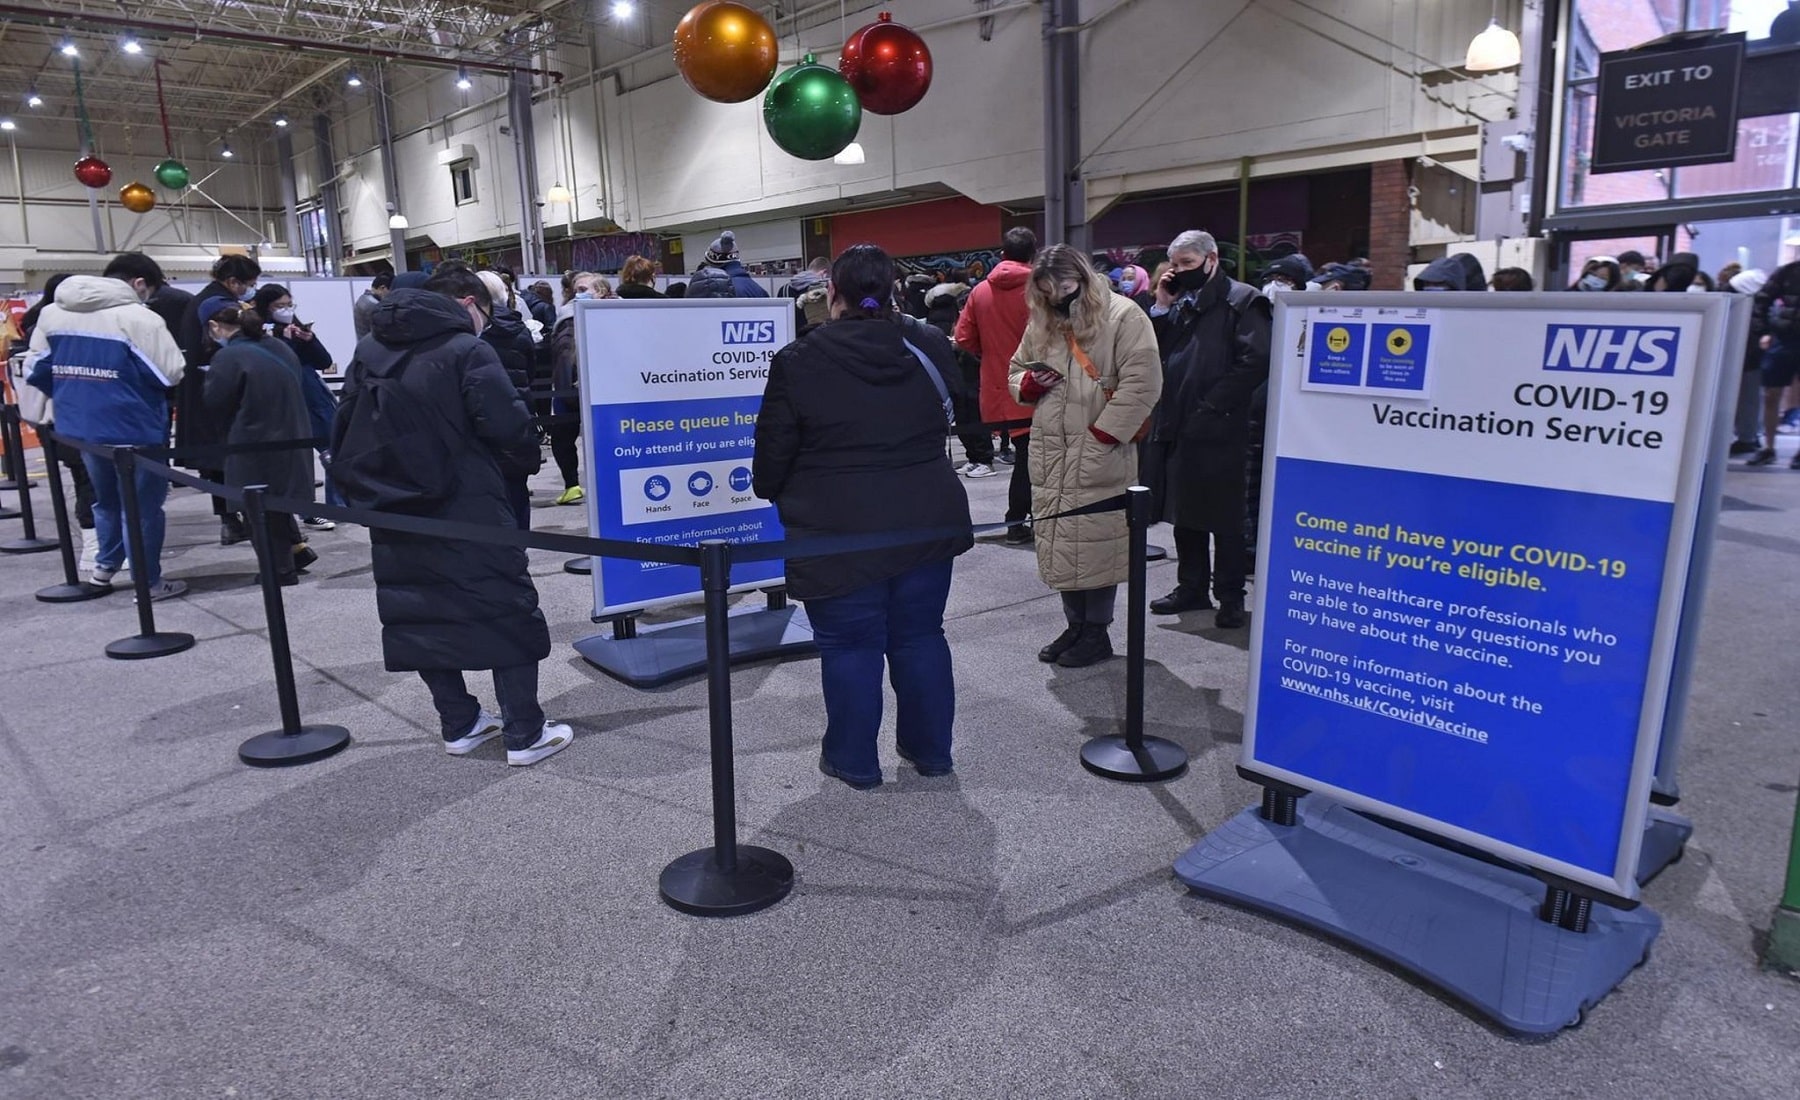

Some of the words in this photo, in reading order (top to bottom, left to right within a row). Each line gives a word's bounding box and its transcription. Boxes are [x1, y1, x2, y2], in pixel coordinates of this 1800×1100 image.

[1625, 69, 1675, 89] EXIT
[1681, 65, 1713, 81] TO
[1615, 106, 1715, 129] VICTORIA
[1634, 129, 1691, 148] GATE
[724, 322, 772, 342] NHS
[712, 350, 775, 364] COVID-19
[1545, 327, 1676, 373] NHS
[640, 368, 724, 384] Vaccination
[729, 366, 769, 380] Servic
[1514, 383, 1669, 415] COVID-19
[620, 418, 674, 433] Please
[680, 416, 730, 432] queue
[734, 411, 759, 425] her
[1373, 403, 1534, 437] Vaccination
[1545, 417, 1663, 449] Service
[614, 445, 642, 458] Only
[645, 442, 682, 454] attend
[685, 441, 693, 451] if
[696, 442, 716, 453] you
[719, 440, 735, 448] are
[738, 436, 756, 448] elig
[645, 504, 671, 514] Hands
[693, 500, 710, 508] Face
[730, 496, 752, 505] Space
[655, 534, 679, 543] more
[682, 526, 735, 539] information
[738, 521, 762, 531] about
[742, 533, 758, 542] visit
[1296, 512, 1347, 533] Come
[1353, 524, 1389, 540] and
[1396, 526, 1445, 549] have
[1452, 539, 1503, 557] your
[1510, 545, 1626, 578] COVID-19
[1294, 537, 1361, 558] vaccine
[1367, 545, 1382, 561] if
[1386, 552, 1451, 574] you’re
[1458, 562, 1546, 591] eligible.
[1291, 569, 1314, 585] We
[1319, 574, 1353, 593] have
[1358, 582, 1443, 611] healthcare
[1448, 604, 1566, 636] professionals
[1573, 627, 1616, 646] who
[1288, 609, 1317, 625] may
[1322, 613, 1356, 632] have
[1360, 624, 1407, 644] about
[1412, 634, 1439, 651] the
[1445, 644, 1512, 668] vaccine.
[1289, 591, 1312, 603] are
[1316, 594, 1347, 611] able
[1352, 602, 1368, 615] to
[1373, 608, 1430, 628] answer
[1435, 622, 1466, 639] any
[1471, 629, 1558, 656] questions
[1564, 648, 1601, 665] you
[1283, 657, 1350, 684] COVID-19
[1355, 679, 1415, 704] vaccine,
[1422, 695, 1454, 712] visit
[1285, 639, 1307, 654] For
[1311, 648, 1348, 665] more
[1353, 656, 1447, 690] information
[1454, 683, 1506, 705] about
[1512, 696, 1542, 714] the
[1281, 676, 1488, 741] www.nhs.uk/CovidVaccine
